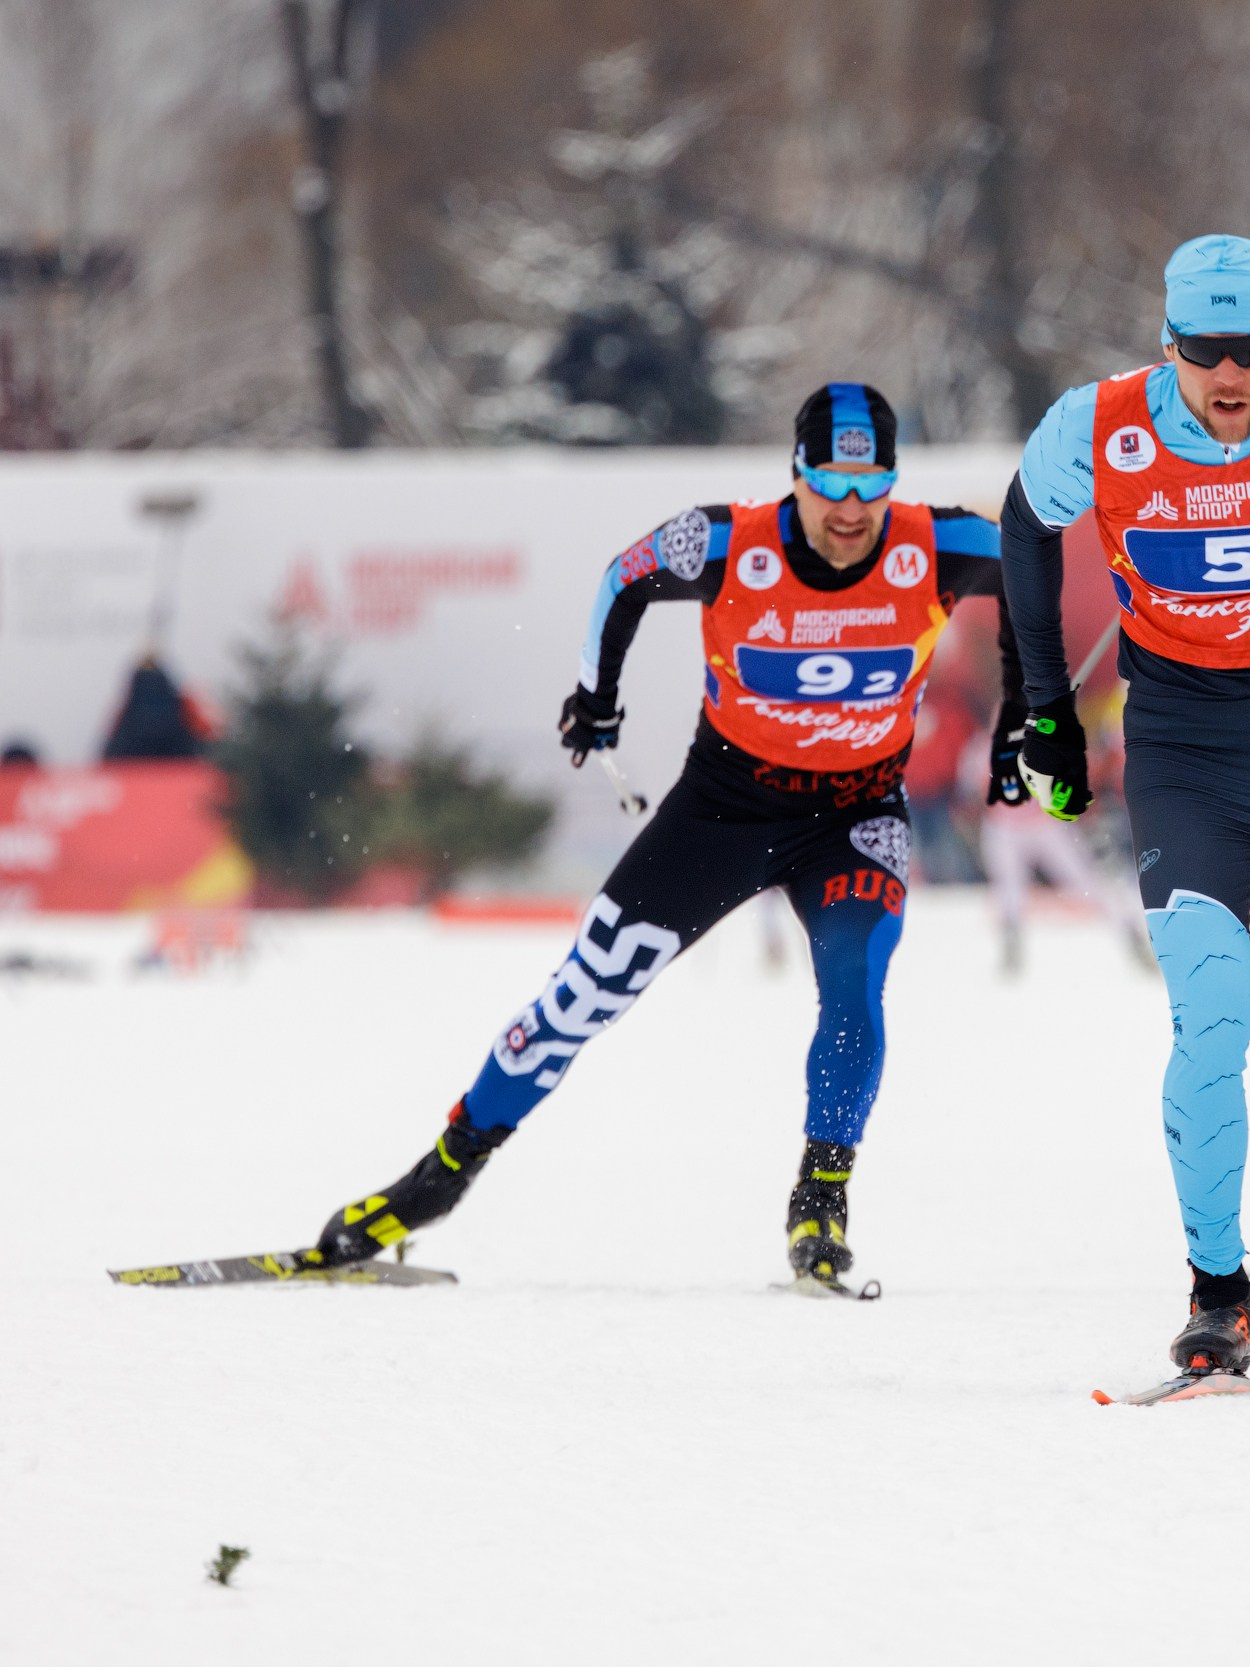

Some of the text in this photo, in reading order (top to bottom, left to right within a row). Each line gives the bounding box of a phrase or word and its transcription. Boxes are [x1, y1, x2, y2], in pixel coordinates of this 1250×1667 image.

[1186, 501, 1243, 521] СПОРТ
[792, 603, 897, 627] МОСКОВСКИЙ
[791, 625, 843, 644] СПОРТ
[796, 654, 898, 695] 9 2
[820, 868, 907, 917] RUS
